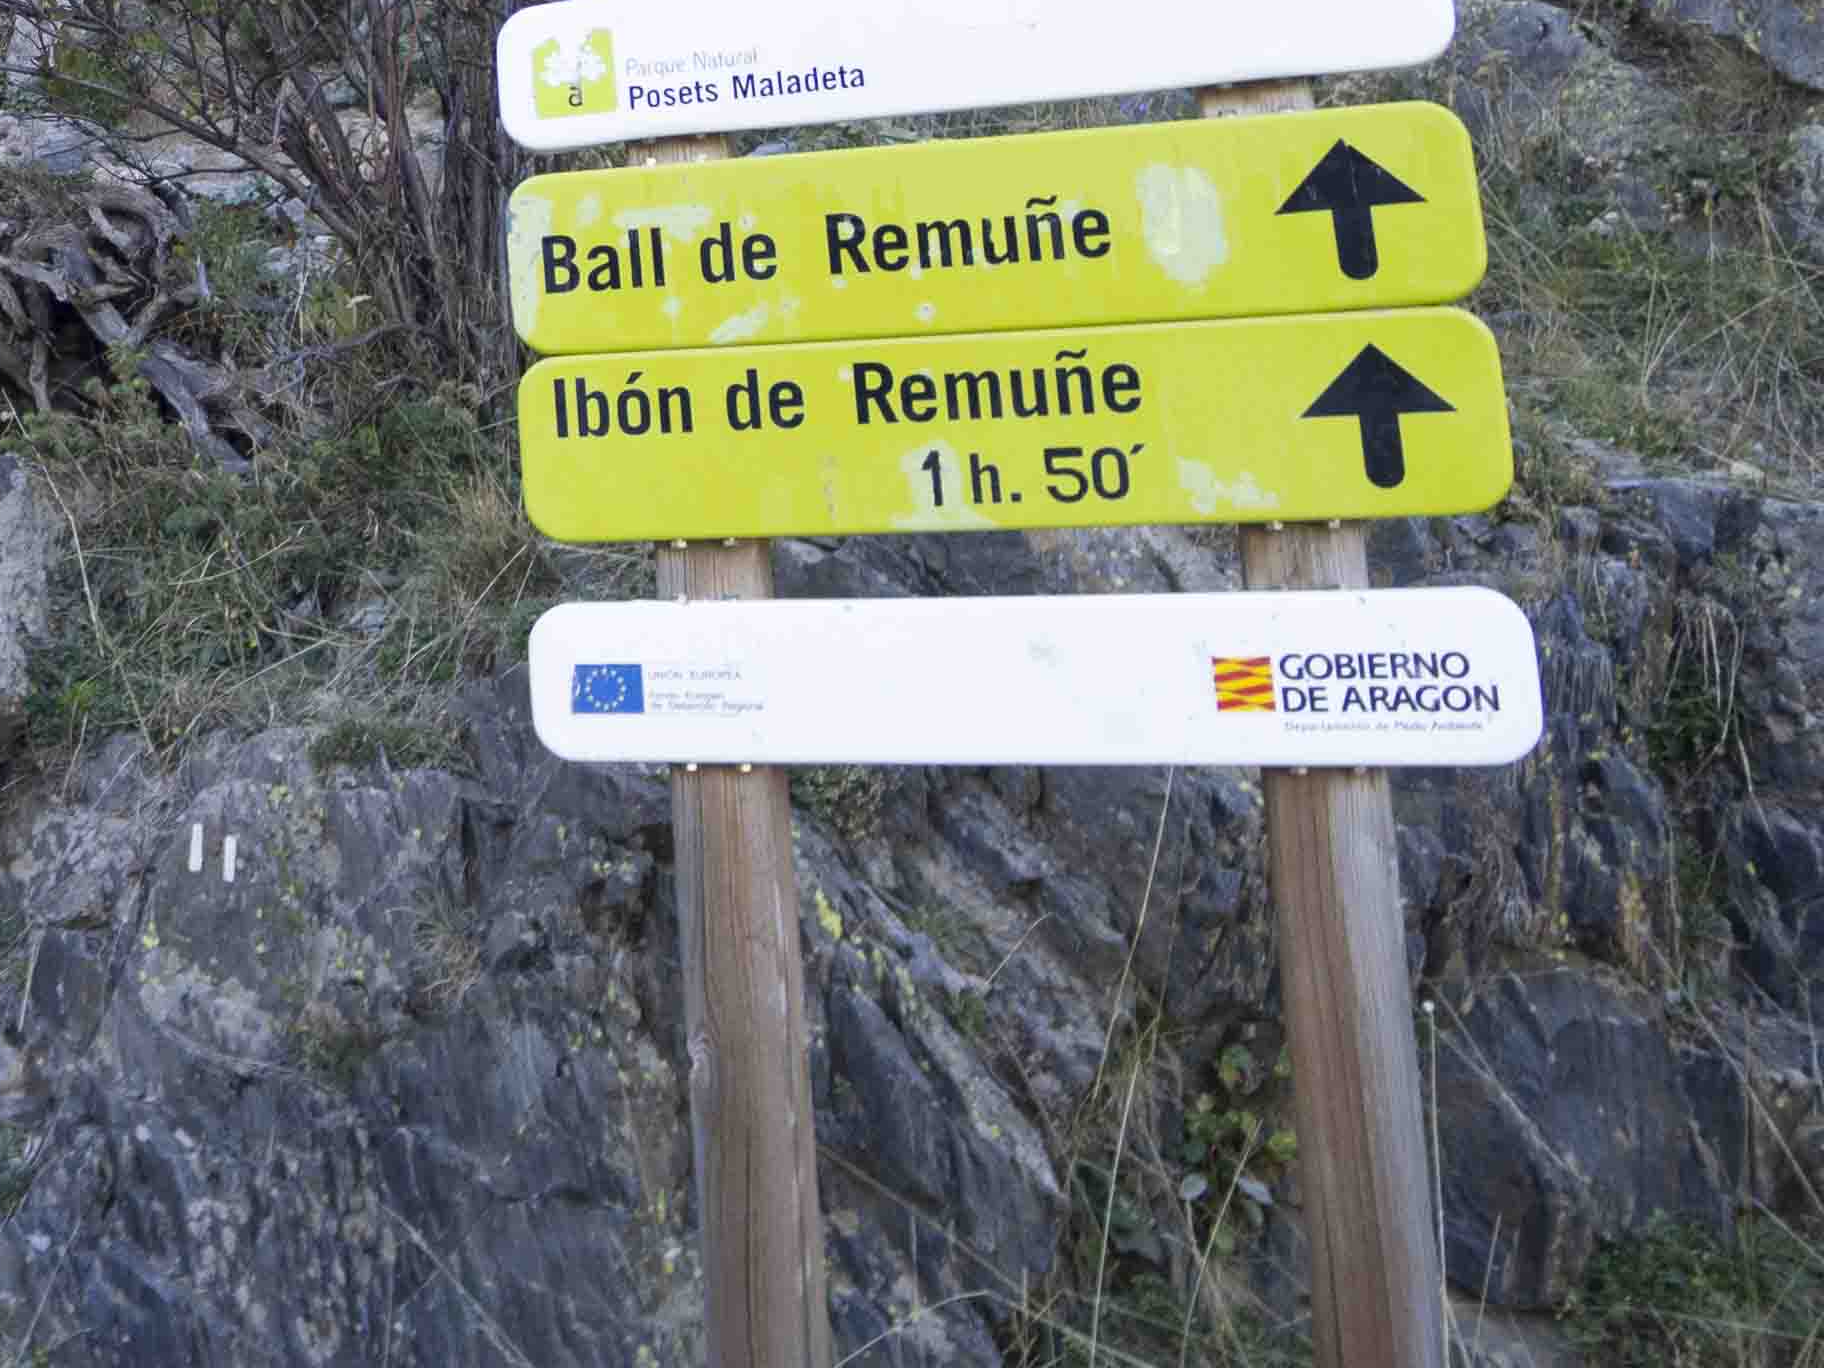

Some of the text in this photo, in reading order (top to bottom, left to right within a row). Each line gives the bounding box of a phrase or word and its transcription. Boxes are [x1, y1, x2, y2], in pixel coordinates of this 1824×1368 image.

[624, 47, 758, 80] Parque Natural
[628, 65, 865, 111] Posets Maladeta
[541, 195, 1111, 294] Ball de Remuñe
[553, 349, 1141, 438] Ibón de Remuñe
[921, 449, 944, 507] 1
[969, 452, 1022, 504] h.
[1279, 651, 1471, 681] GOBIERNO
[1281, 684, 1501, 713] DE ARAGON
